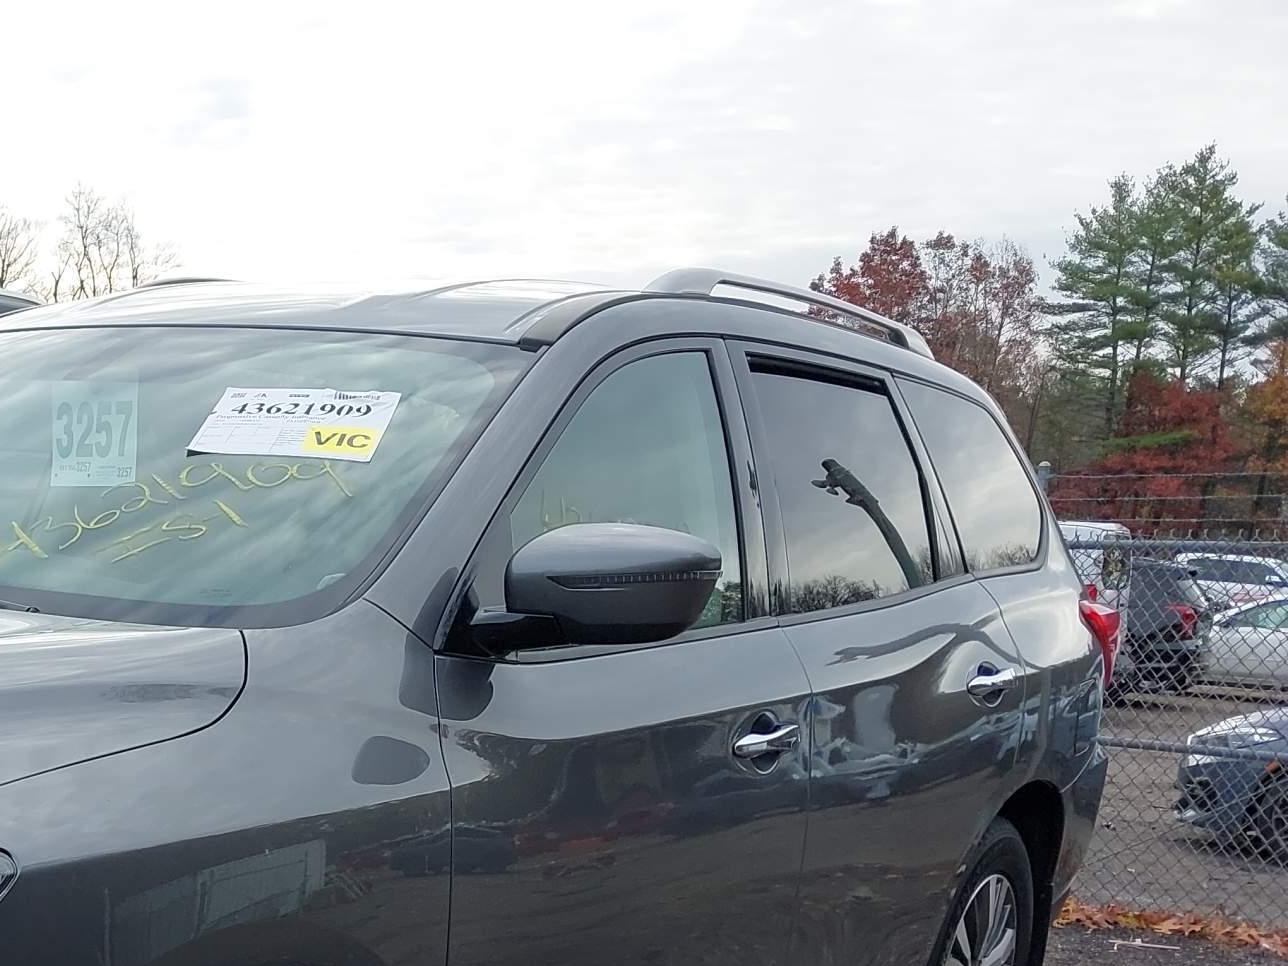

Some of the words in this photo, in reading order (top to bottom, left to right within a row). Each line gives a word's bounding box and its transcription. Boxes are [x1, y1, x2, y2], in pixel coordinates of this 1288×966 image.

[231, 402, 373, 419] 43621909
[55, 401, 133, 459] 3257
[314, 430, 372, 449] VIC
